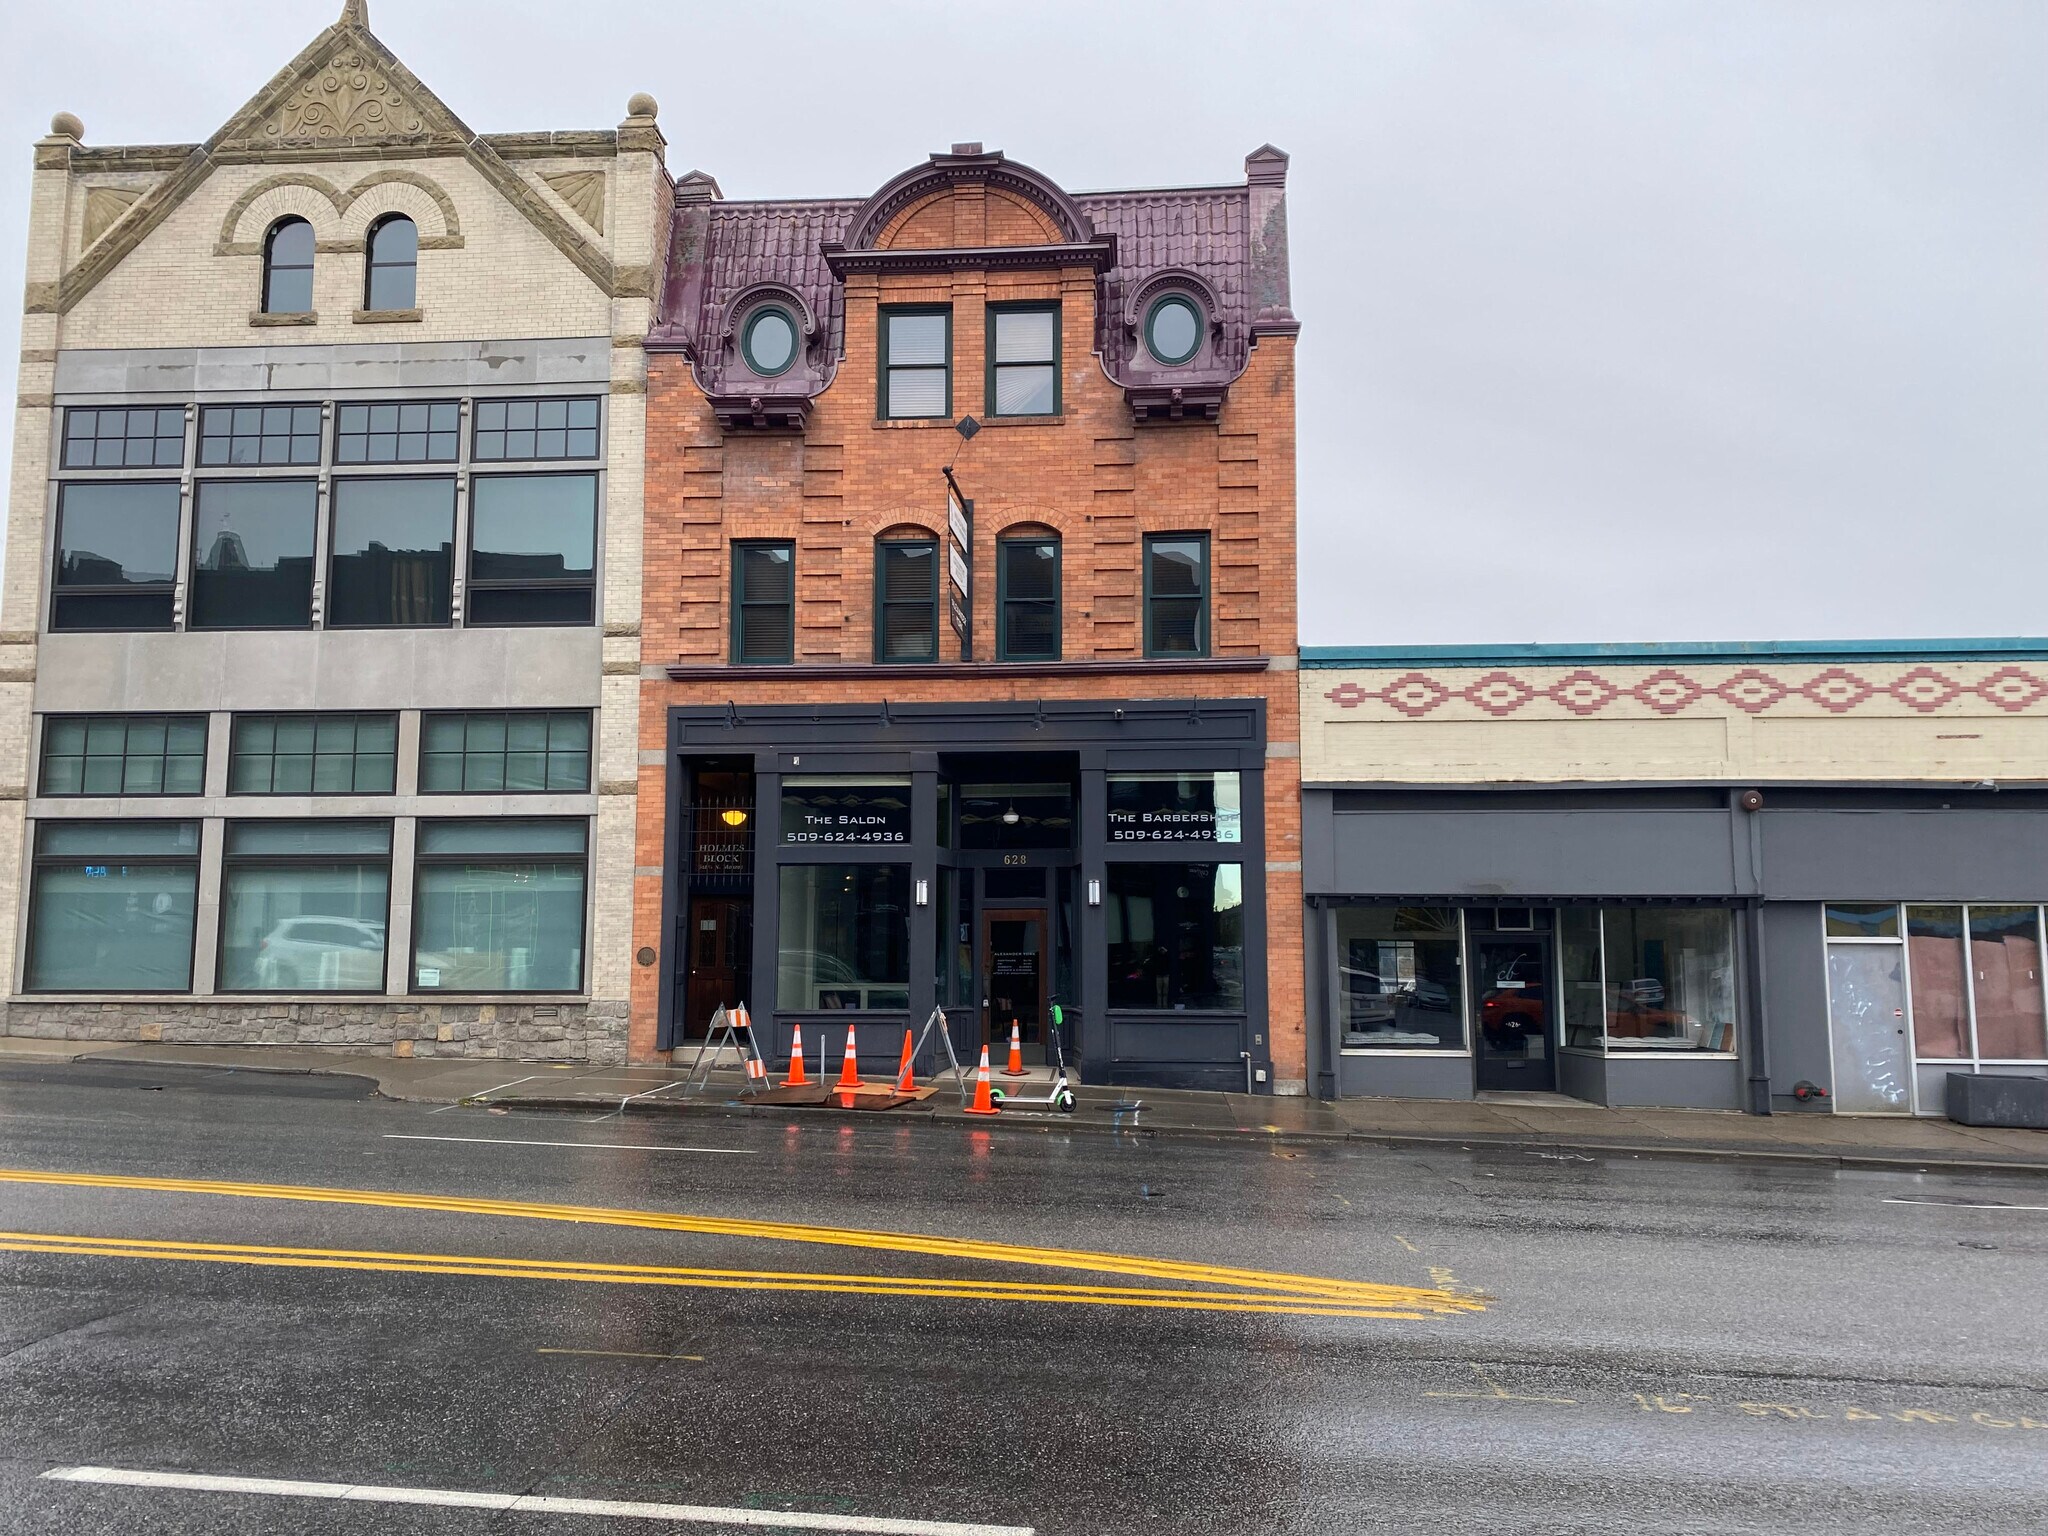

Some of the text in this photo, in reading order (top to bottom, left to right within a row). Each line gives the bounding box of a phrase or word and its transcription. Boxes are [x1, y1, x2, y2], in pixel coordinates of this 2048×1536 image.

[787, 831, 904, 842] 509-624-4936
[1114, 829, 1234, 840] 509-624-4936
[699, 844, 745, 853] HOLMES
[703, 854, 739, 863] BLOCK
[1003, 854, 1027, 865] 628
